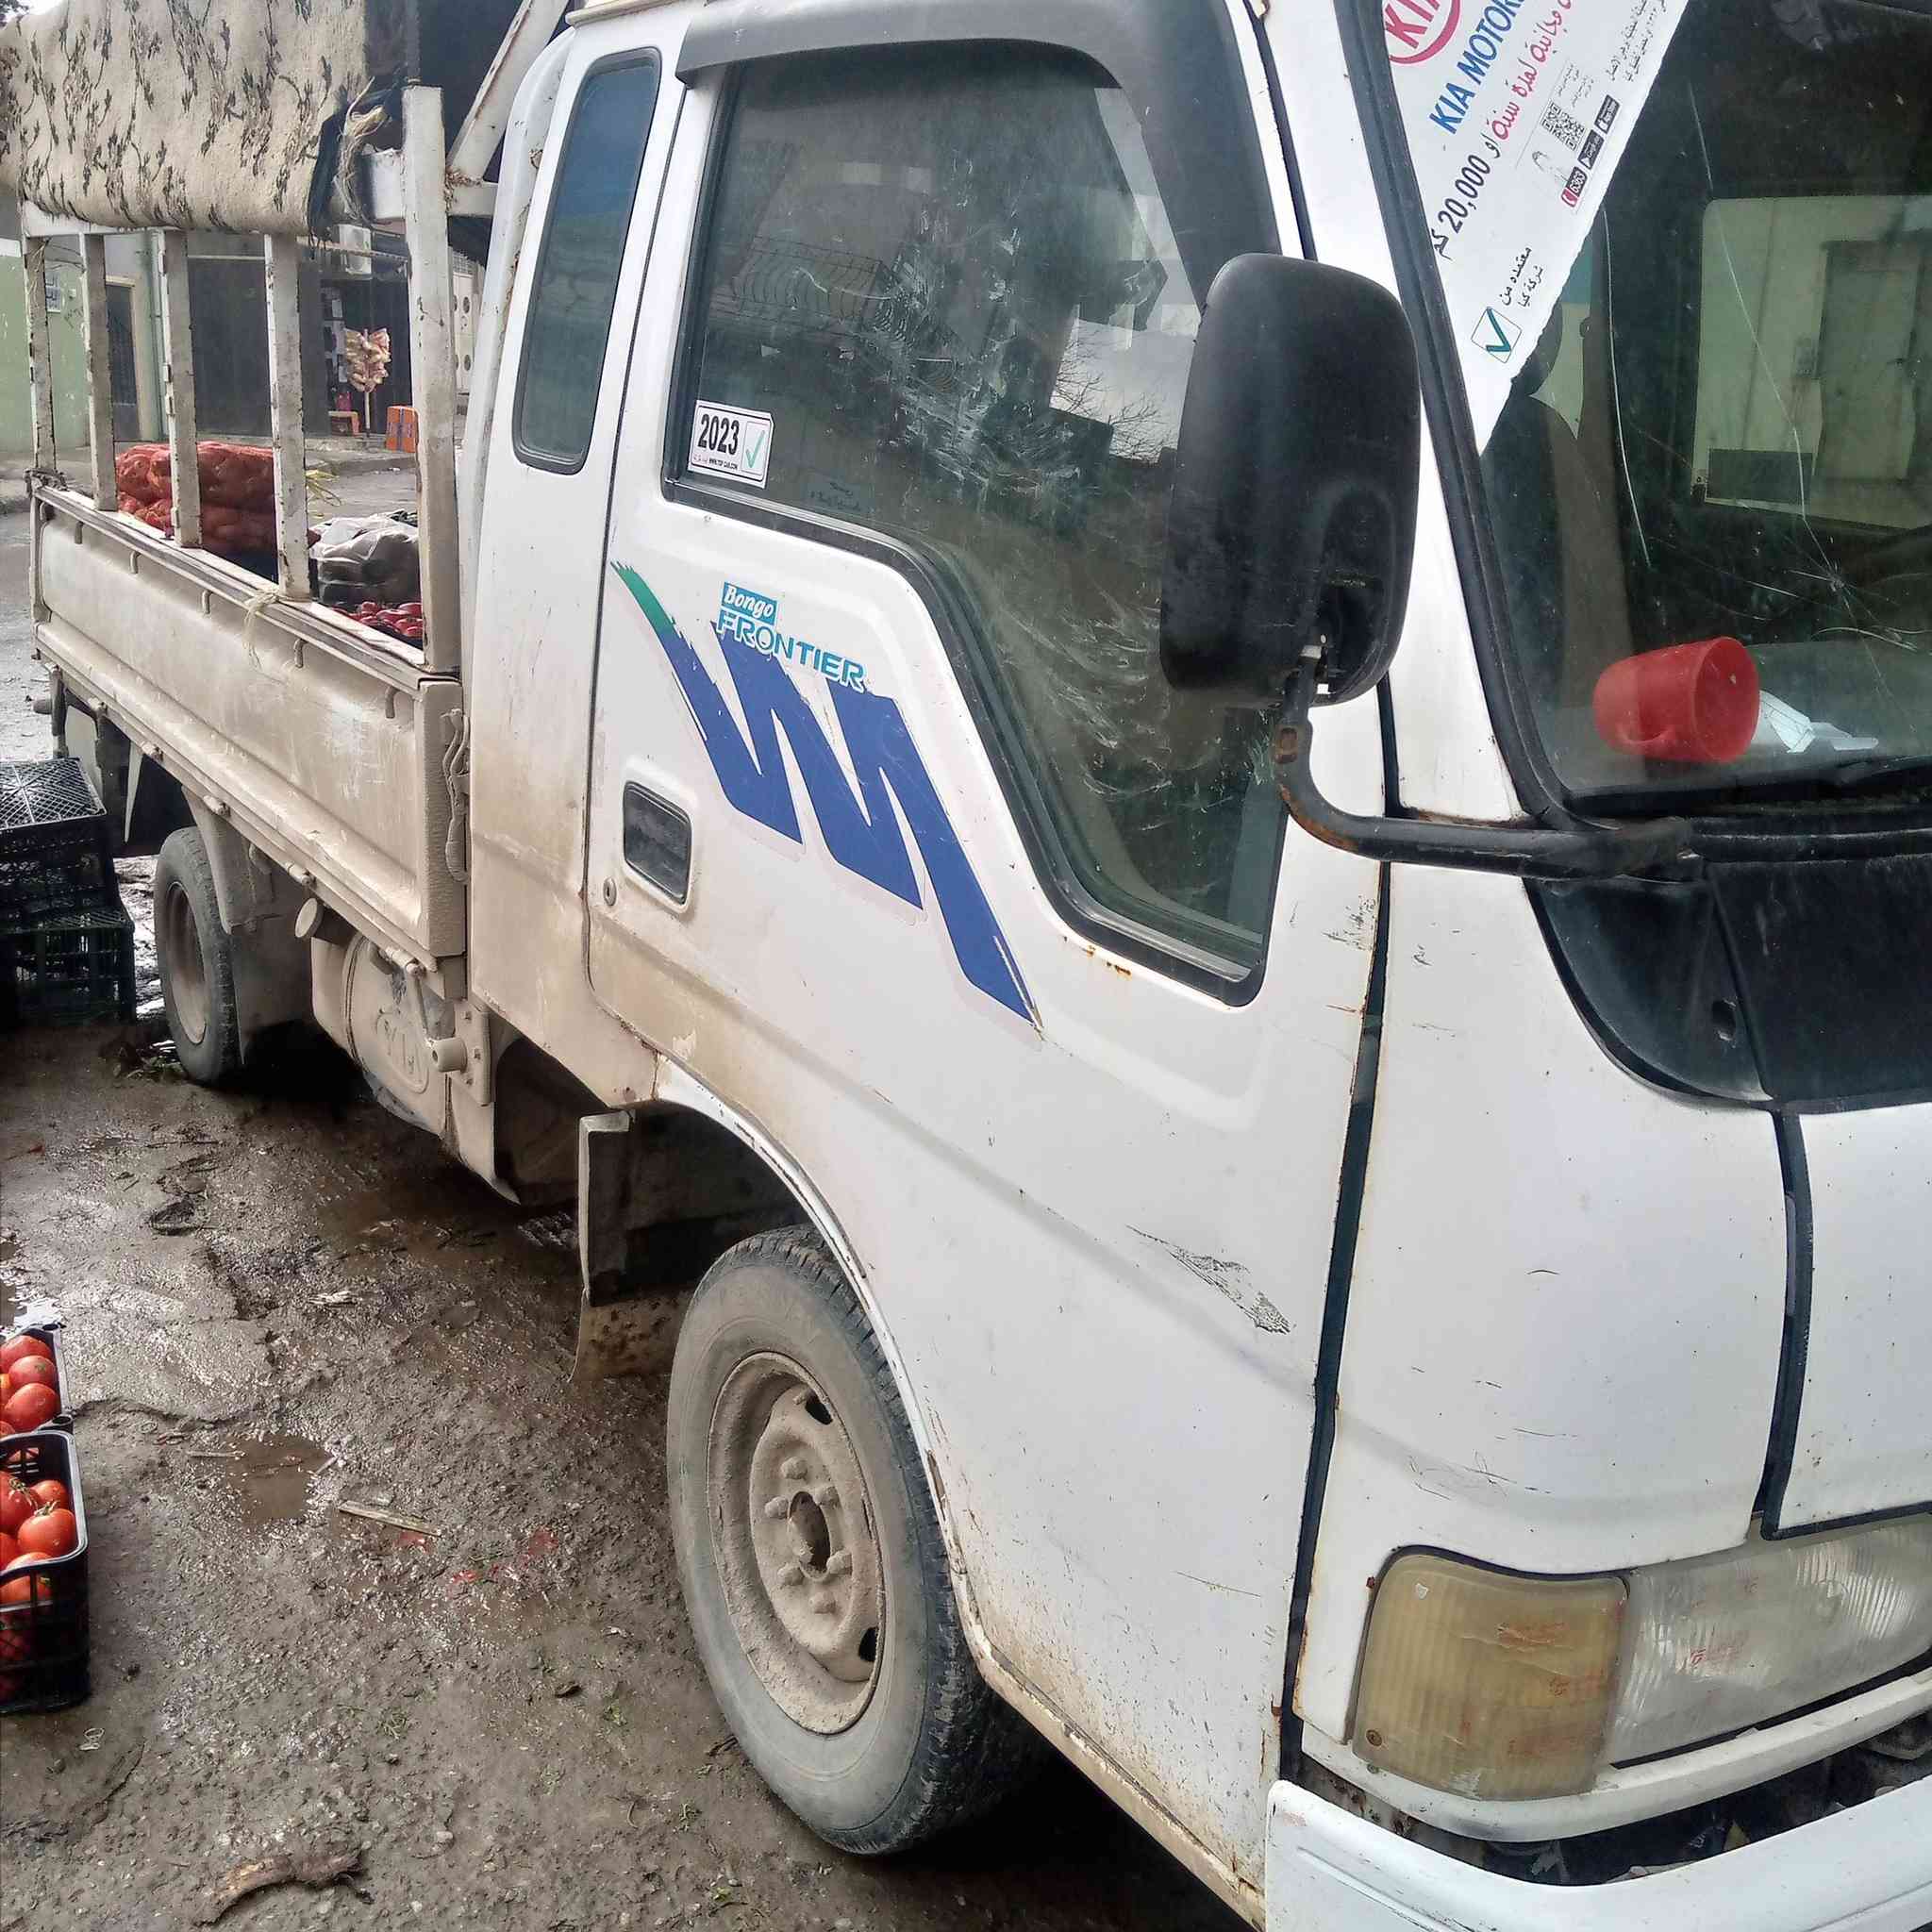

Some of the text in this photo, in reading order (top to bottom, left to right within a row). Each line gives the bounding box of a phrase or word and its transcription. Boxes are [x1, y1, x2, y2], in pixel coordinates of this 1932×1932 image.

[1428, 0, 1525, 135] KIA MOTOR
[1486, 101, 1521, 140] سنة
[1438, 154, 1491, 234] 20,000
[1431, 228, 1454, 261] كم
[1499, 286, 1513, 306] من
[1518, 291, 1530, 307] كيا
[697, 413, 740, 456] 2023
[724, 585, 774, 618] Bongo
[716, 609, 867, 693] FRONTIER
